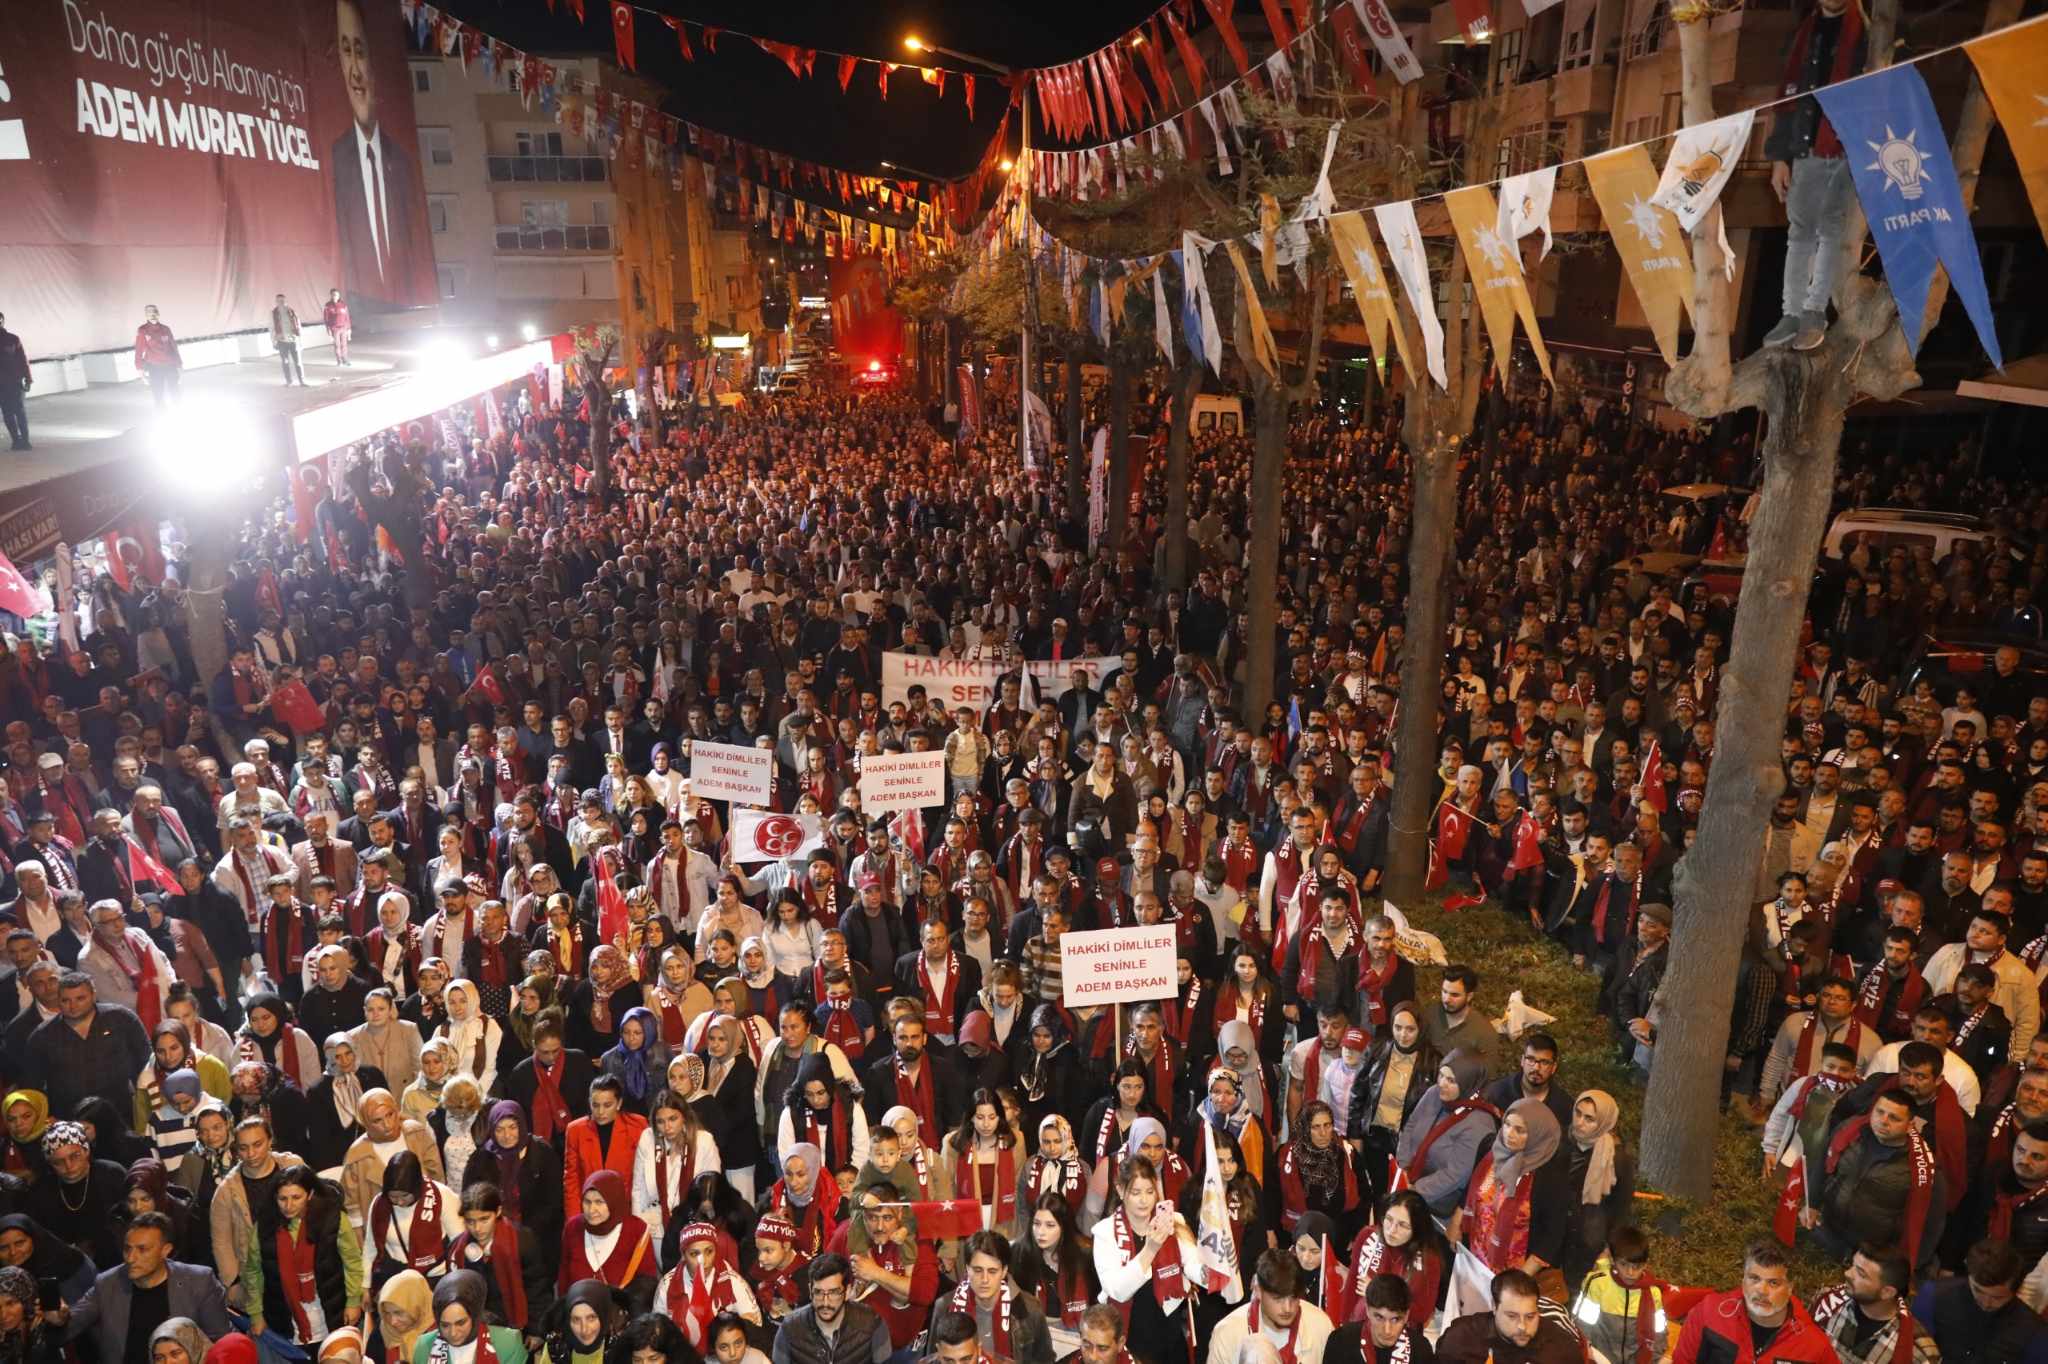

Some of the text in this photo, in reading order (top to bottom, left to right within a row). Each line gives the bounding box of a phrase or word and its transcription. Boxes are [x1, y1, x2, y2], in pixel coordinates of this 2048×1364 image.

[63, 0, 306, 119] Daha güçlü Alanya için
[76, 78, 165, 147] ADEM
[163, 98, 256, 159] MURAT
[253, 109, 320, 170] YÜCEL
[869, 792, 897, 802] ADEM
[1066, 937, 1173, 957] HAKİKİ DİMLİLER
[1093, 959, 1148, 974] SENİNLE
[1075, 976, 1168, 994] ADEM BAŞKAN
